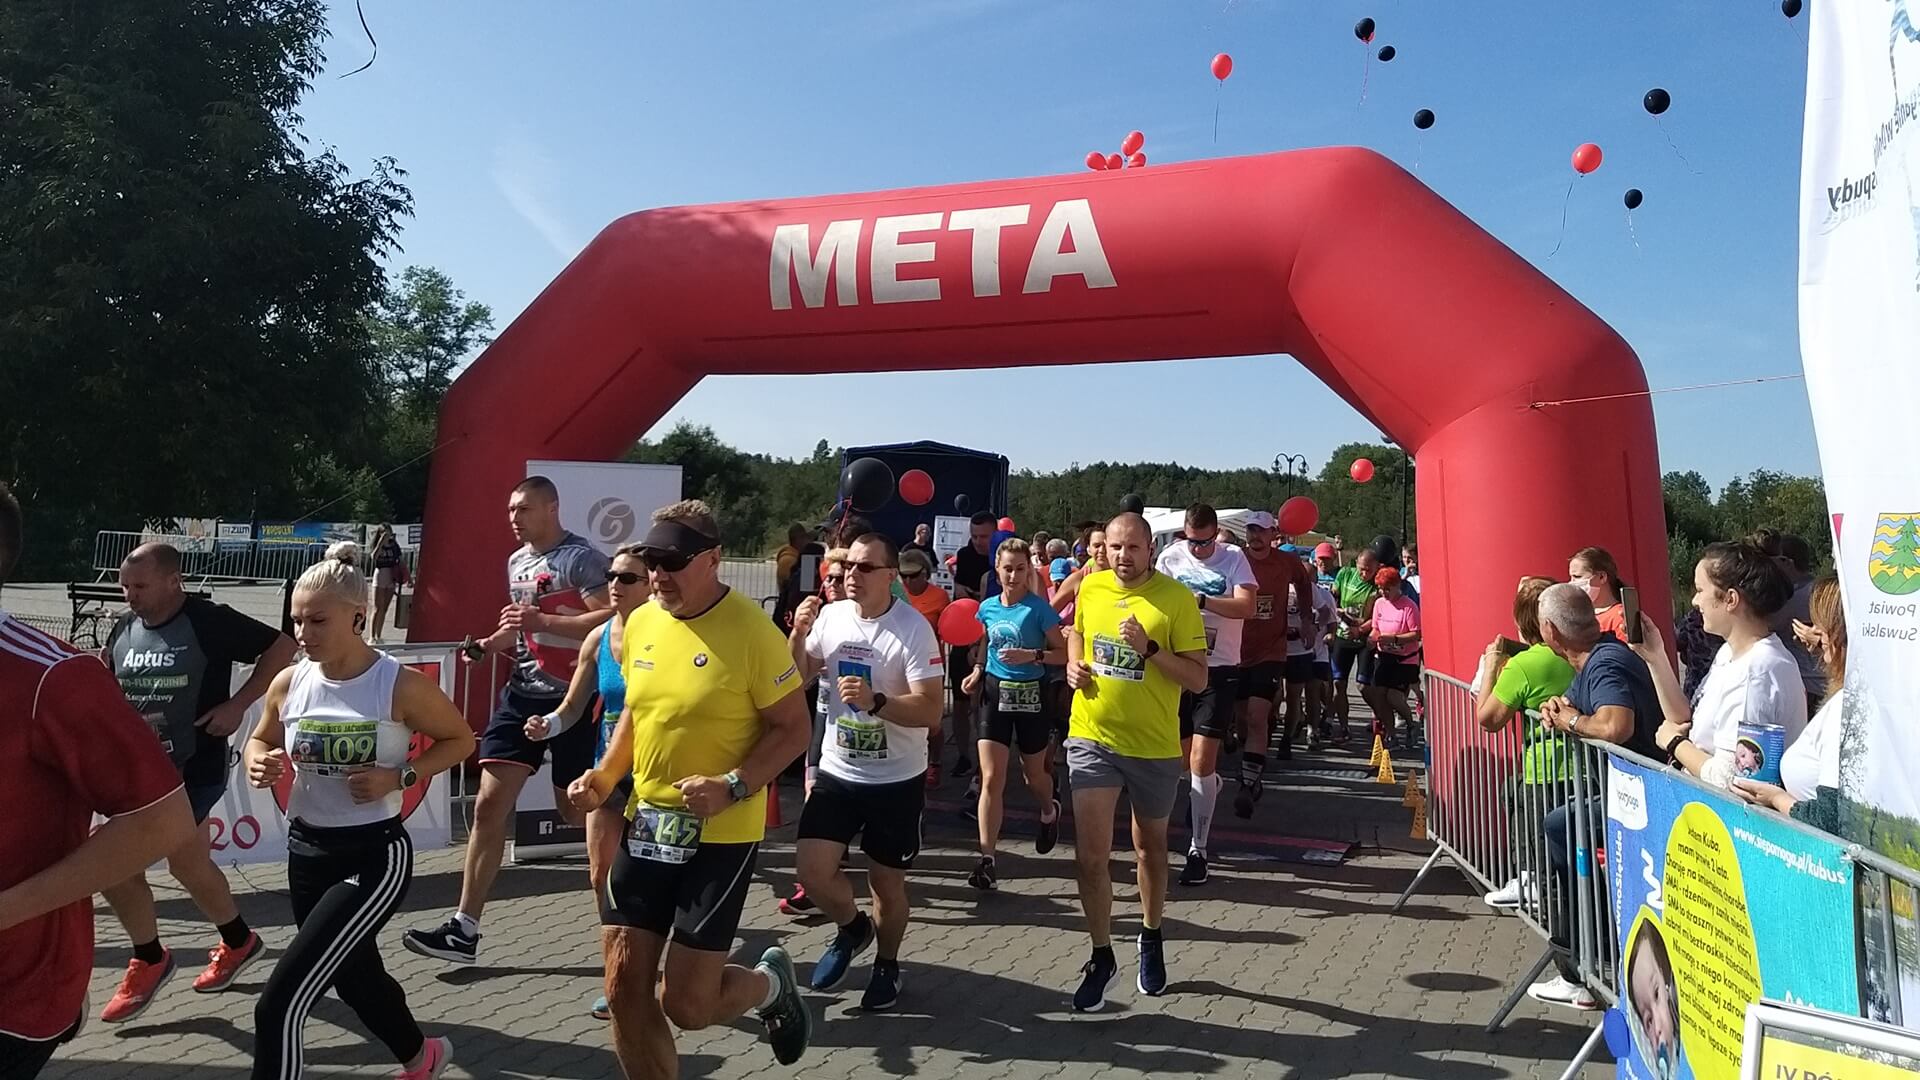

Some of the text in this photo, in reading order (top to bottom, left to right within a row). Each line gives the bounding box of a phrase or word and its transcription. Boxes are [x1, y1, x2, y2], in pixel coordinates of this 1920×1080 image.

[769, 198, 1118, 310] META
[122, 648, 176, 671] Aptus
[1015, 690, 1039, 704] 146
[321, 735, 374, 764] 109
[854, 730, 885, 750] 159
[654, 812, 700, 846] 145
[1677, 843, 1694, 858] mam
[1687, 867, 1697, 879] na
[1682, 884, 1715, 916] rdzeniowy
[1667, 894, 1679, 911] SMA
[1686, 907, 1714, 937] straszny
[1701, 961, 1722, 984] niego
[1707, 989, 1721, 1010] mój
[1715, 1015, 1728, 1033] ale
